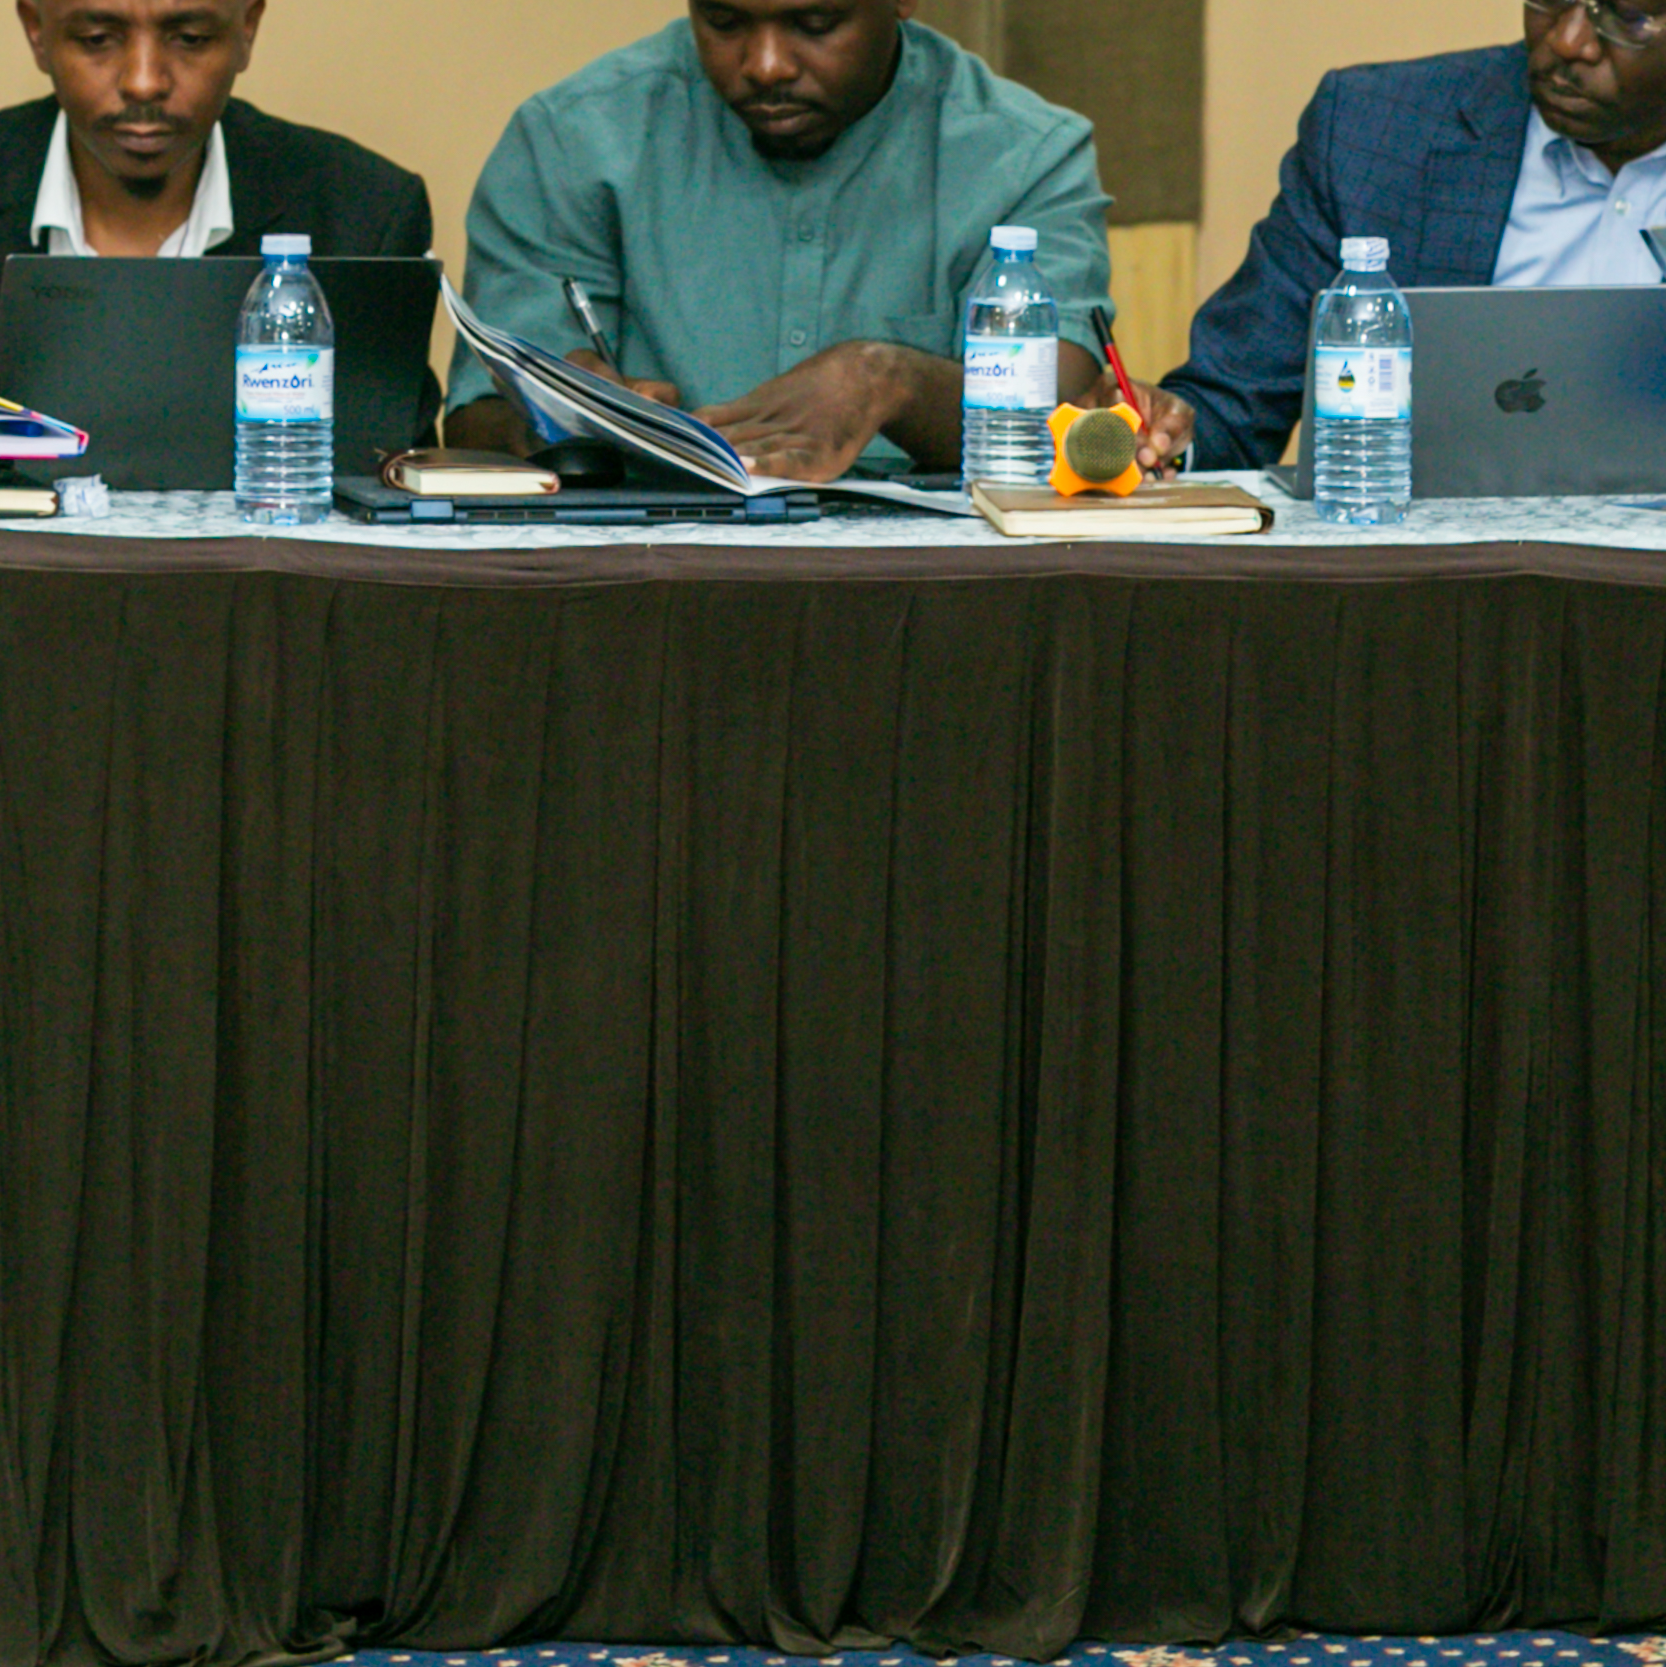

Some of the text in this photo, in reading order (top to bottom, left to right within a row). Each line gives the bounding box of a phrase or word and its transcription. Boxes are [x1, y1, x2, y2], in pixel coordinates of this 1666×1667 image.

[243, 374, 312, 388] Rwenzori
[283, 403, 314, 415] 500 ml
